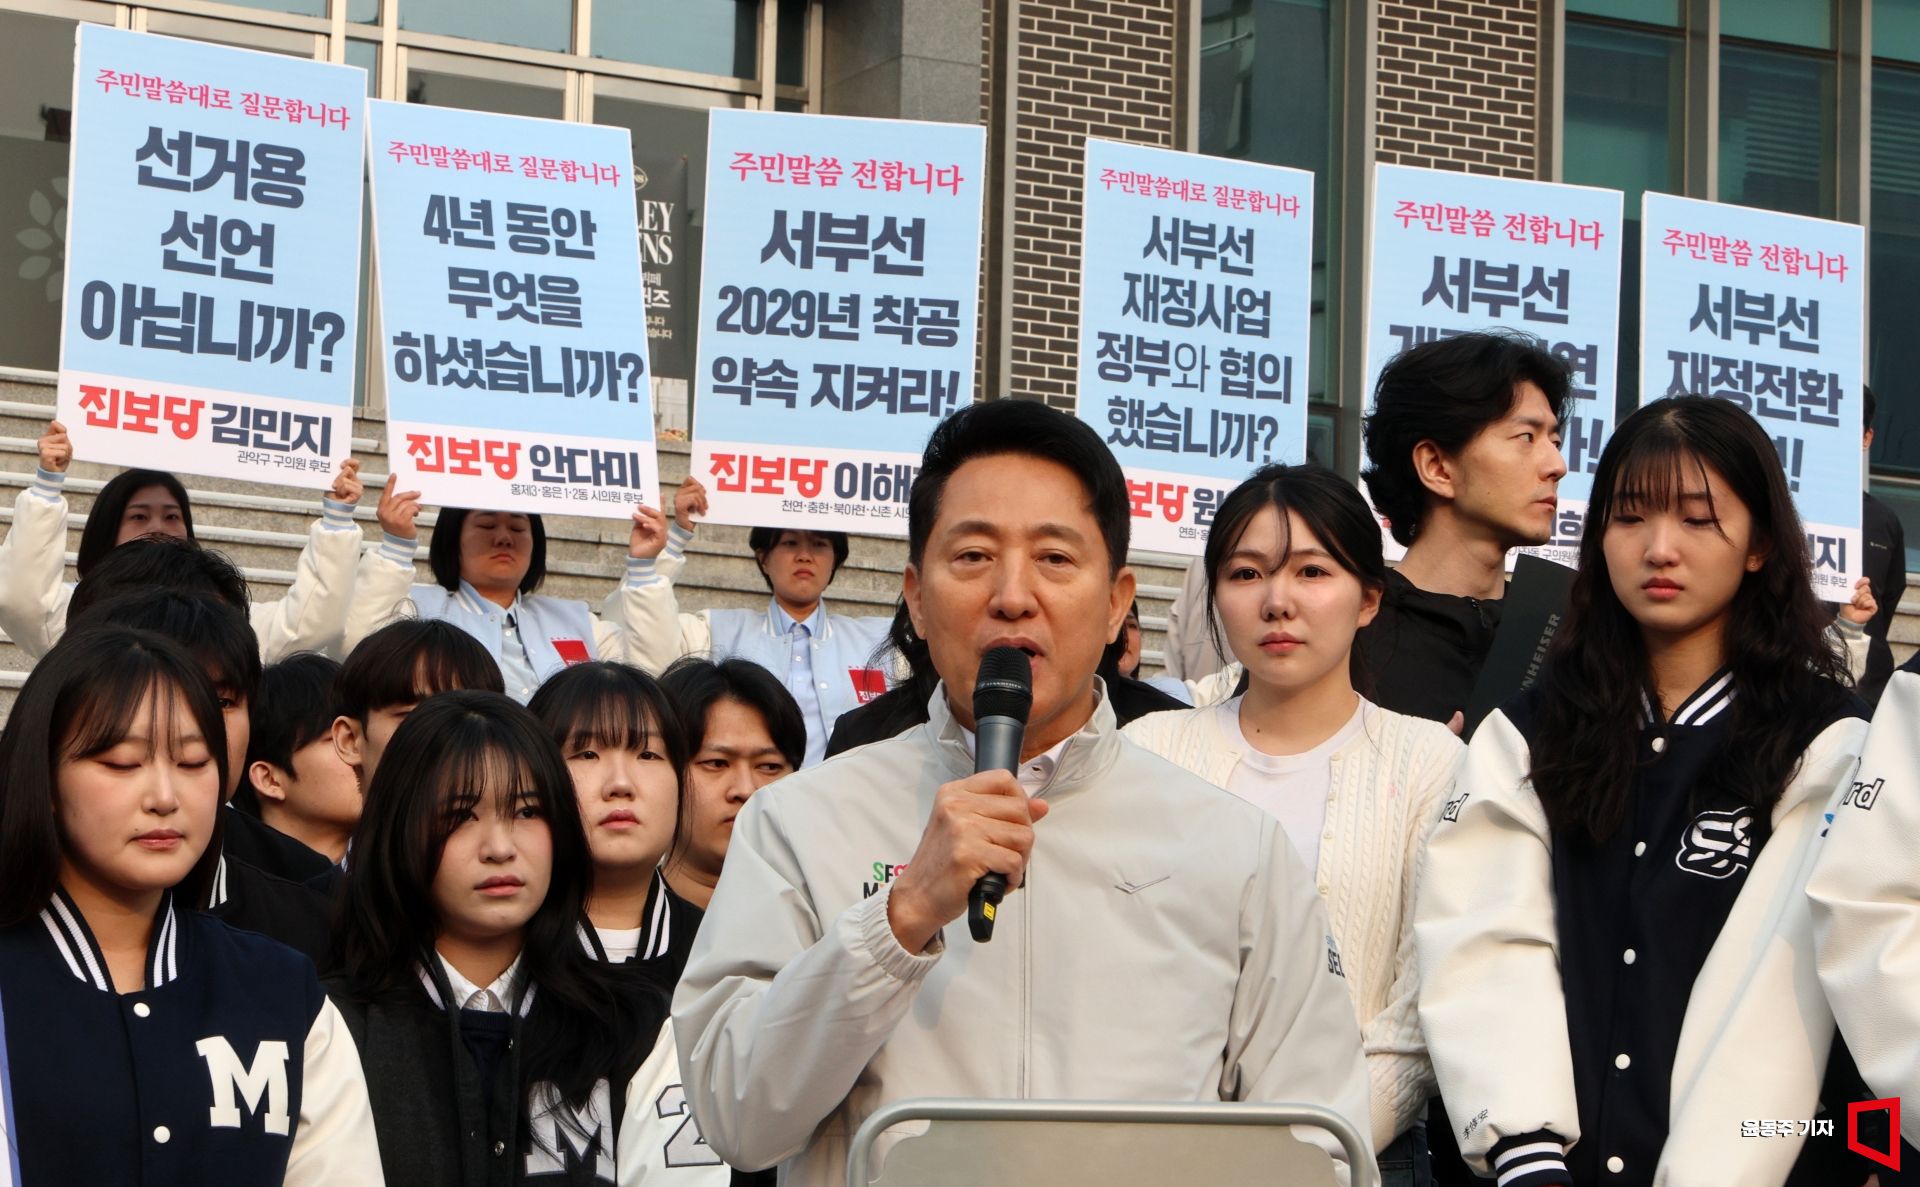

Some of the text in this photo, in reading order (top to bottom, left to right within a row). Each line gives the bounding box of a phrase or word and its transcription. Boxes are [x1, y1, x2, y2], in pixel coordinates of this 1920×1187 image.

[96, 68, 351, 131] 주민말씀대로 질문합니다
[135, 126, 306, 209] 선거용
[387, 141, 621, 187] 주민말씀대로 질문합니다
[729, 151, 964, 196] 주민말씀 전합니다
[1100, 168, 1300, 218] 주민말씀대로 질문합니다
[160, 210, 276, 285] 선언
[423, 193, 598, 260] 4년 동안
[638, 200, 675, 233] EY
[760, 209, 926, 277] 서부선
[1143, 215, 1254, 276] 서부선
[1393, 201, 1604, 251] 주민말씀 전합니다
[639, 233, 673, 265] NS
[1662, 228, 1848, 283] 주민말씀 전합니다
[447, 266, 583, 328] 무엇을
[716, 284, 960, 348] 2029년 착공
[1122, 273, 1271, 339] 재정사업
[1422, 255, 1570, 324] 서부선
[1689, 283, 1820, 354] 서부선
[80, 279, 346, 373] 아닙니까?
[392, 331, 644, 404] 하셨습니까?
[711, 355, 961, 416] 약속 지켜라!
[1096, 331, 1292, 404] 정부와 협의
[1667, 350, 1843, 427] 재정전환
[78, 384, 332, 457] 진보당 김민지
[1107, 396, 1279, 463] 했습니까?
[238, 450, 331, 473] 관악구 구의원 후보
[406, 434, 641, 490] 진보당 안다미
[708, 452, 921, 504] 진보당 이해
[591, 490, 621, 503] 시의원
[623, 492, 644, 504] 후보
[1127, 479, 1189, 522] 보당
[1520, 613, 1561, 692] NHEISER
[1840, 772, 1885, 811] rd
[195, 1035, 289, 1136] M
[523, 1078, 616, 1184] M
